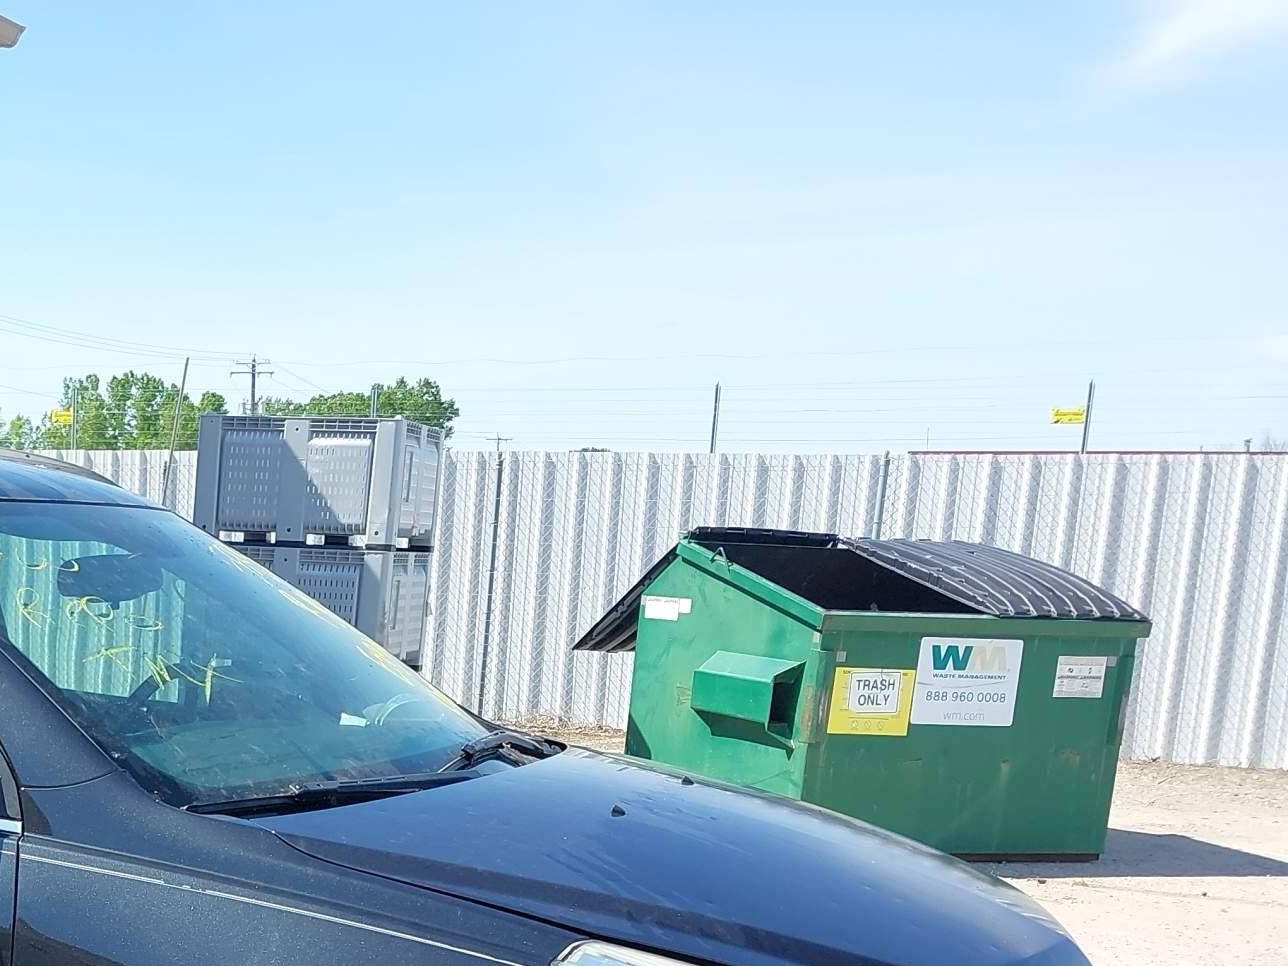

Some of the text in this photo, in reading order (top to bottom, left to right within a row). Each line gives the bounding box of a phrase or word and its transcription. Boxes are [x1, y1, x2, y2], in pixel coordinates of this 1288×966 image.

[932, 644, 1008, 673] WM
[856, 679, 896, 691] TRASH
[857, 694, 890, 706] ONLY
[925, 690, 1006, 703] 888 960 0008
[943, 711, 985, 721] wm.com
